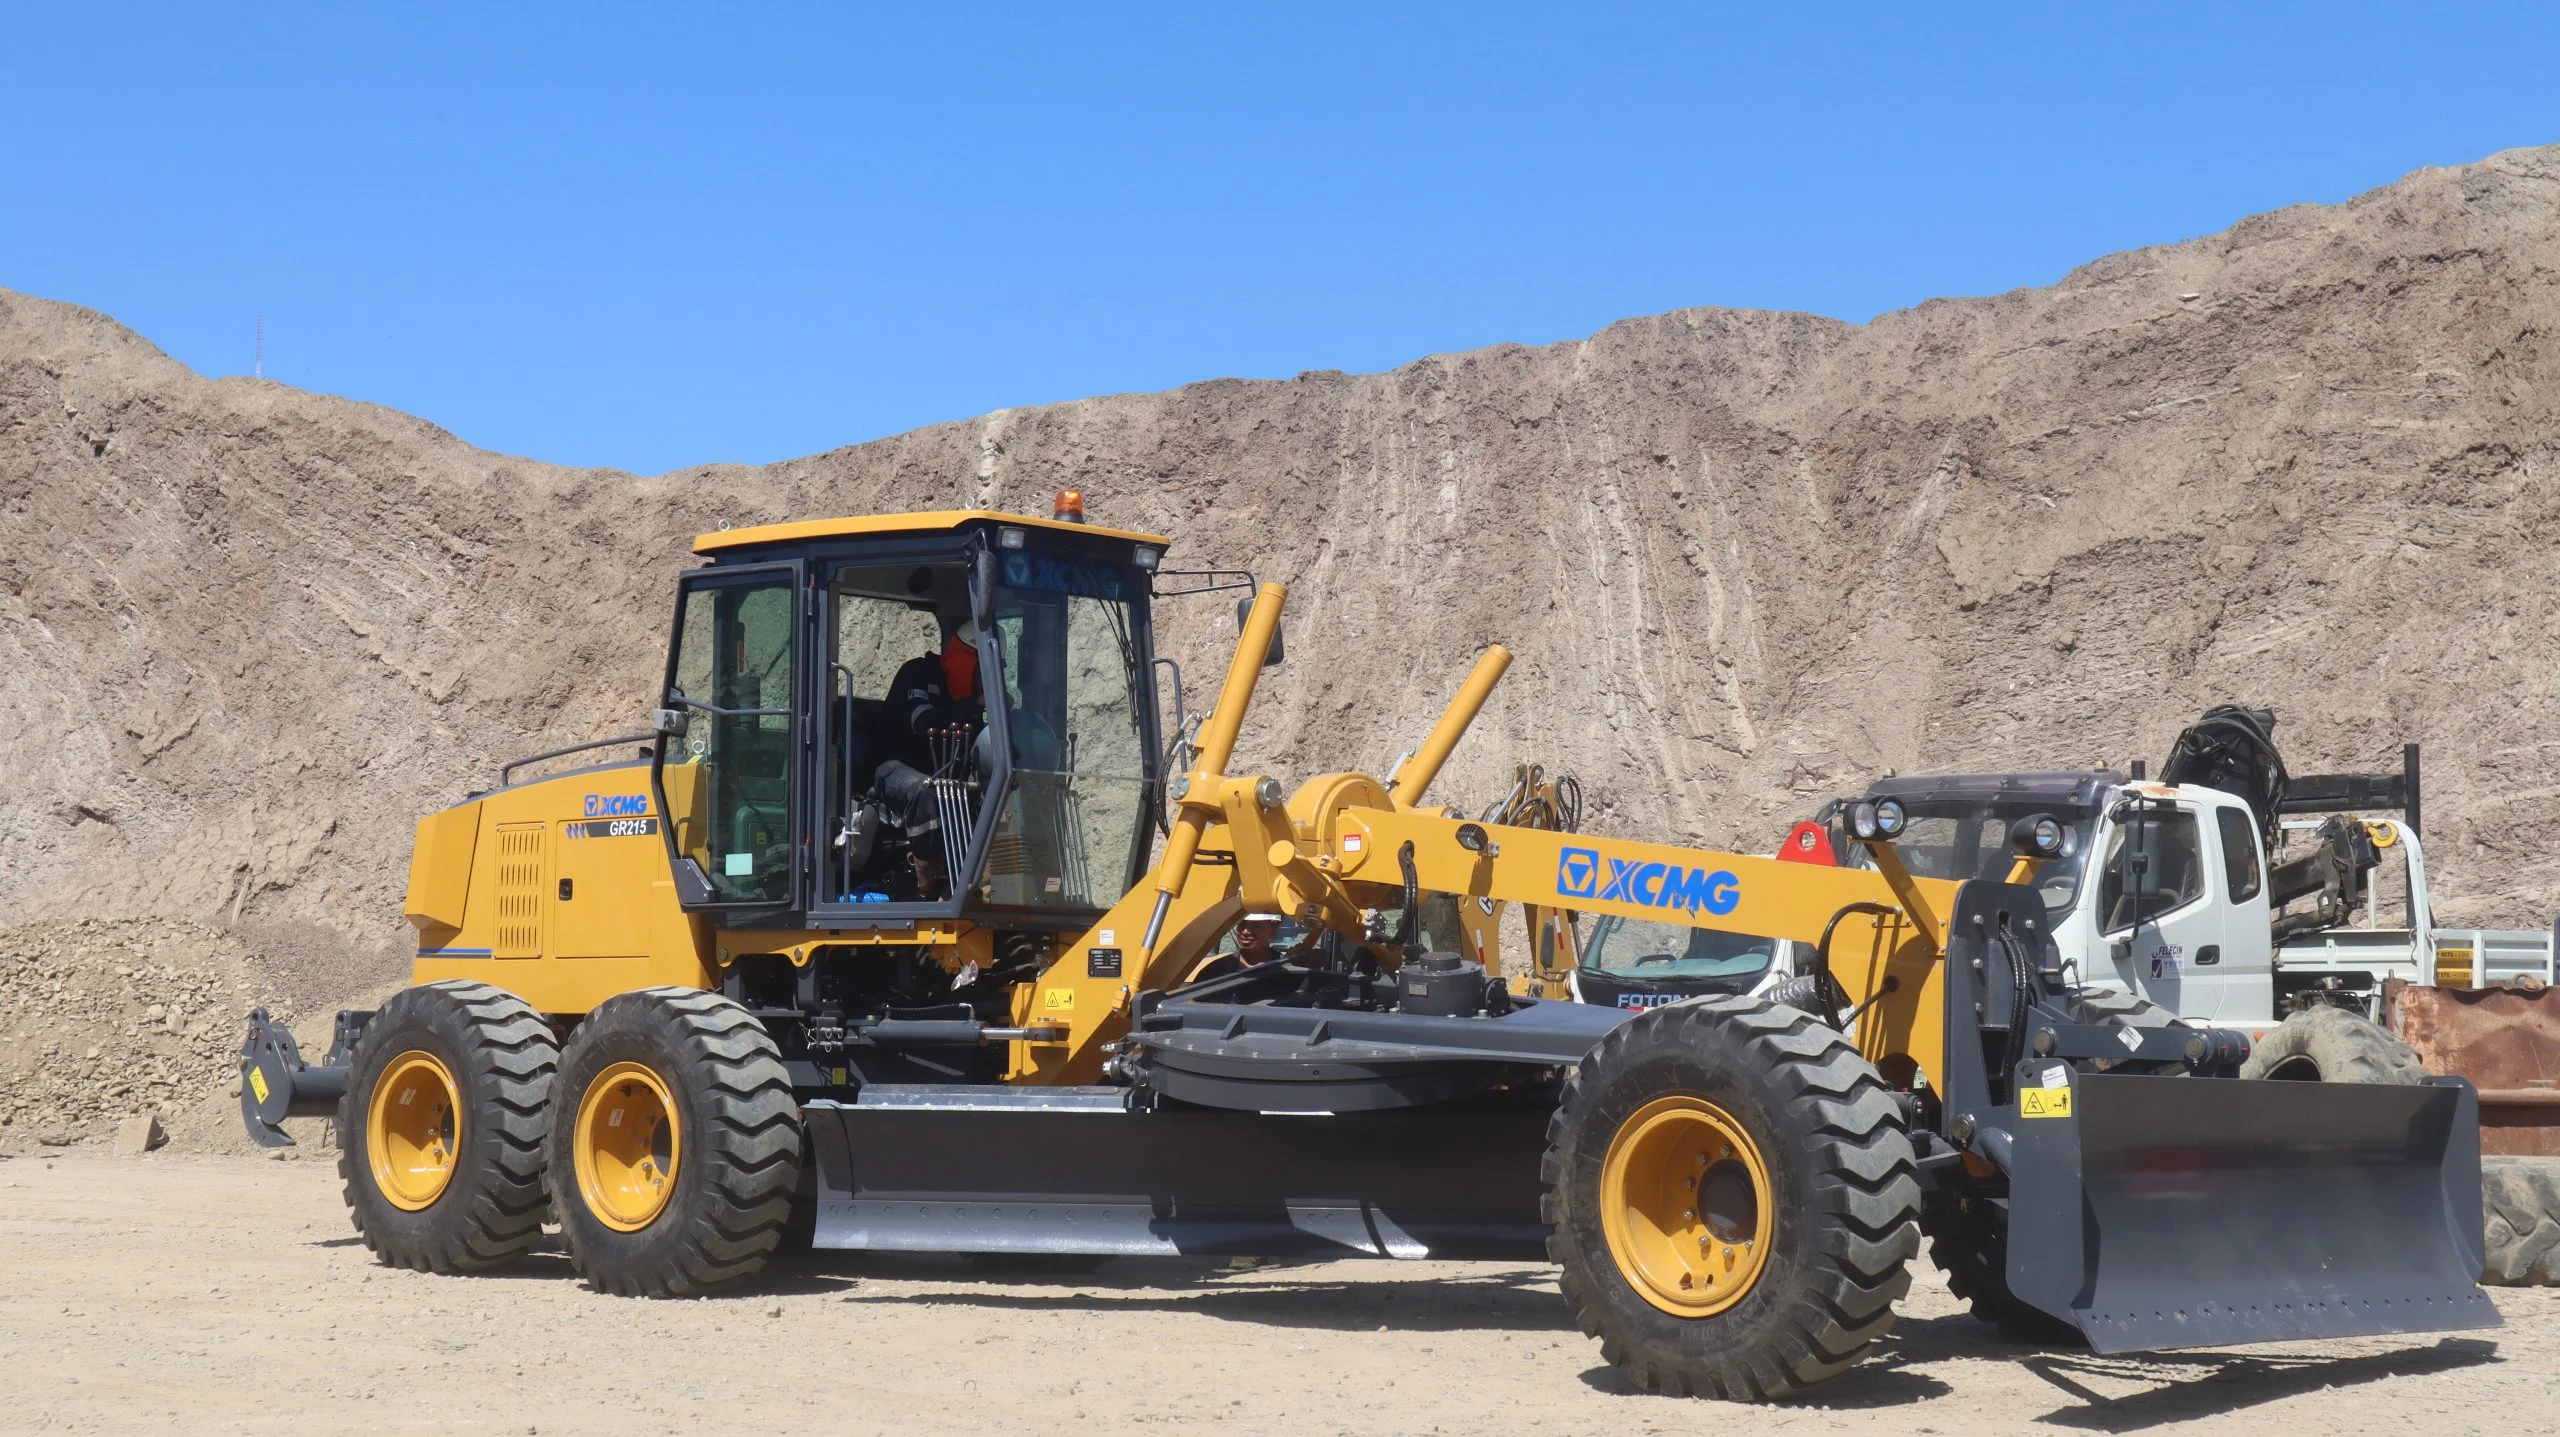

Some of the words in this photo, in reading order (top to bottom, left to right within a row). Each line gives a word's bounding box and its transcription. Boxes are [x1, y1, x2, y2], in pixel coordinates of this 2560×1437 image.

[1033, 556, 1124, 599] XCMG
[600, 795, 648, 816] XCMG
[609, 820, 647, 836] GR215
[1596, 858, 1740, 916] XCMG
